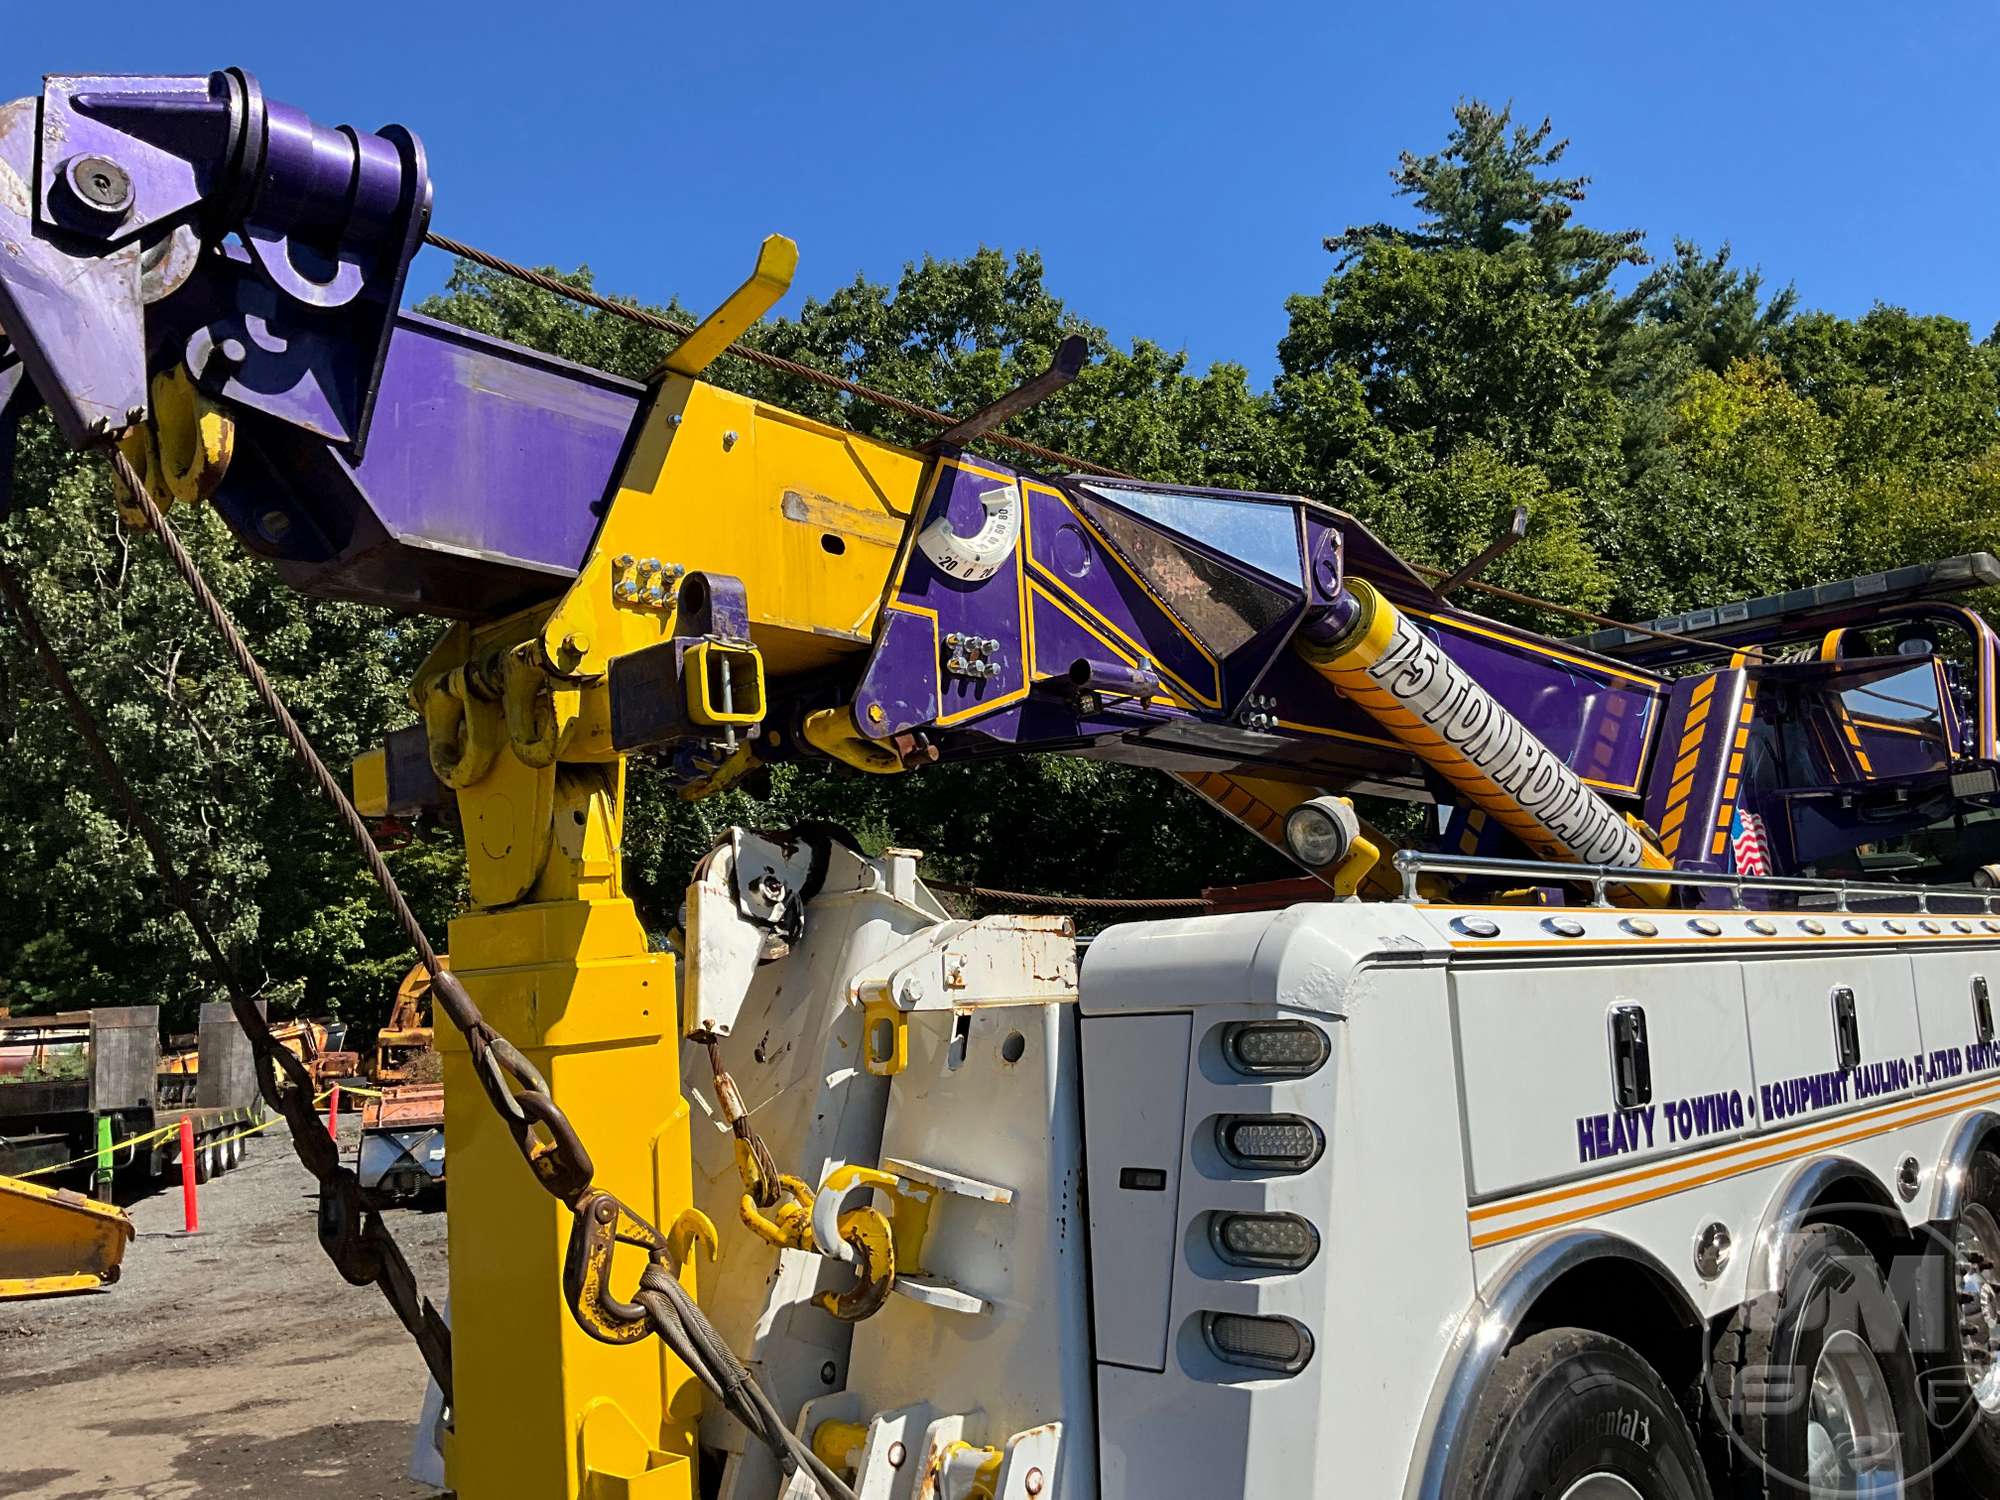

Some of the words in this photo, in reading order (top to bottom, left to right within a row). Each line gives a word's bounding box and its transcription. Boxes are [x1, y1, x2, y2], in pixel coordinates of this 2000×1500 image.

[938, 555, 958, 571] -20
[962, 567, 973, 578] 0
[1369, 615, 1439, 699] 75
[1422, 660, 1512, 766] TON
[1491, 728, 1644, 868] ROTATOR
[1576, 1104, 1655, 1163] HEAVY
[1663, 1089, 1744, 1142] TOWING
[1760, 1070, 1849, 1122] EQUIPMENT
[1855, 1057, 1909, 1100] HAULING
[1914, 1047, 1963, 1084] FLATBED
